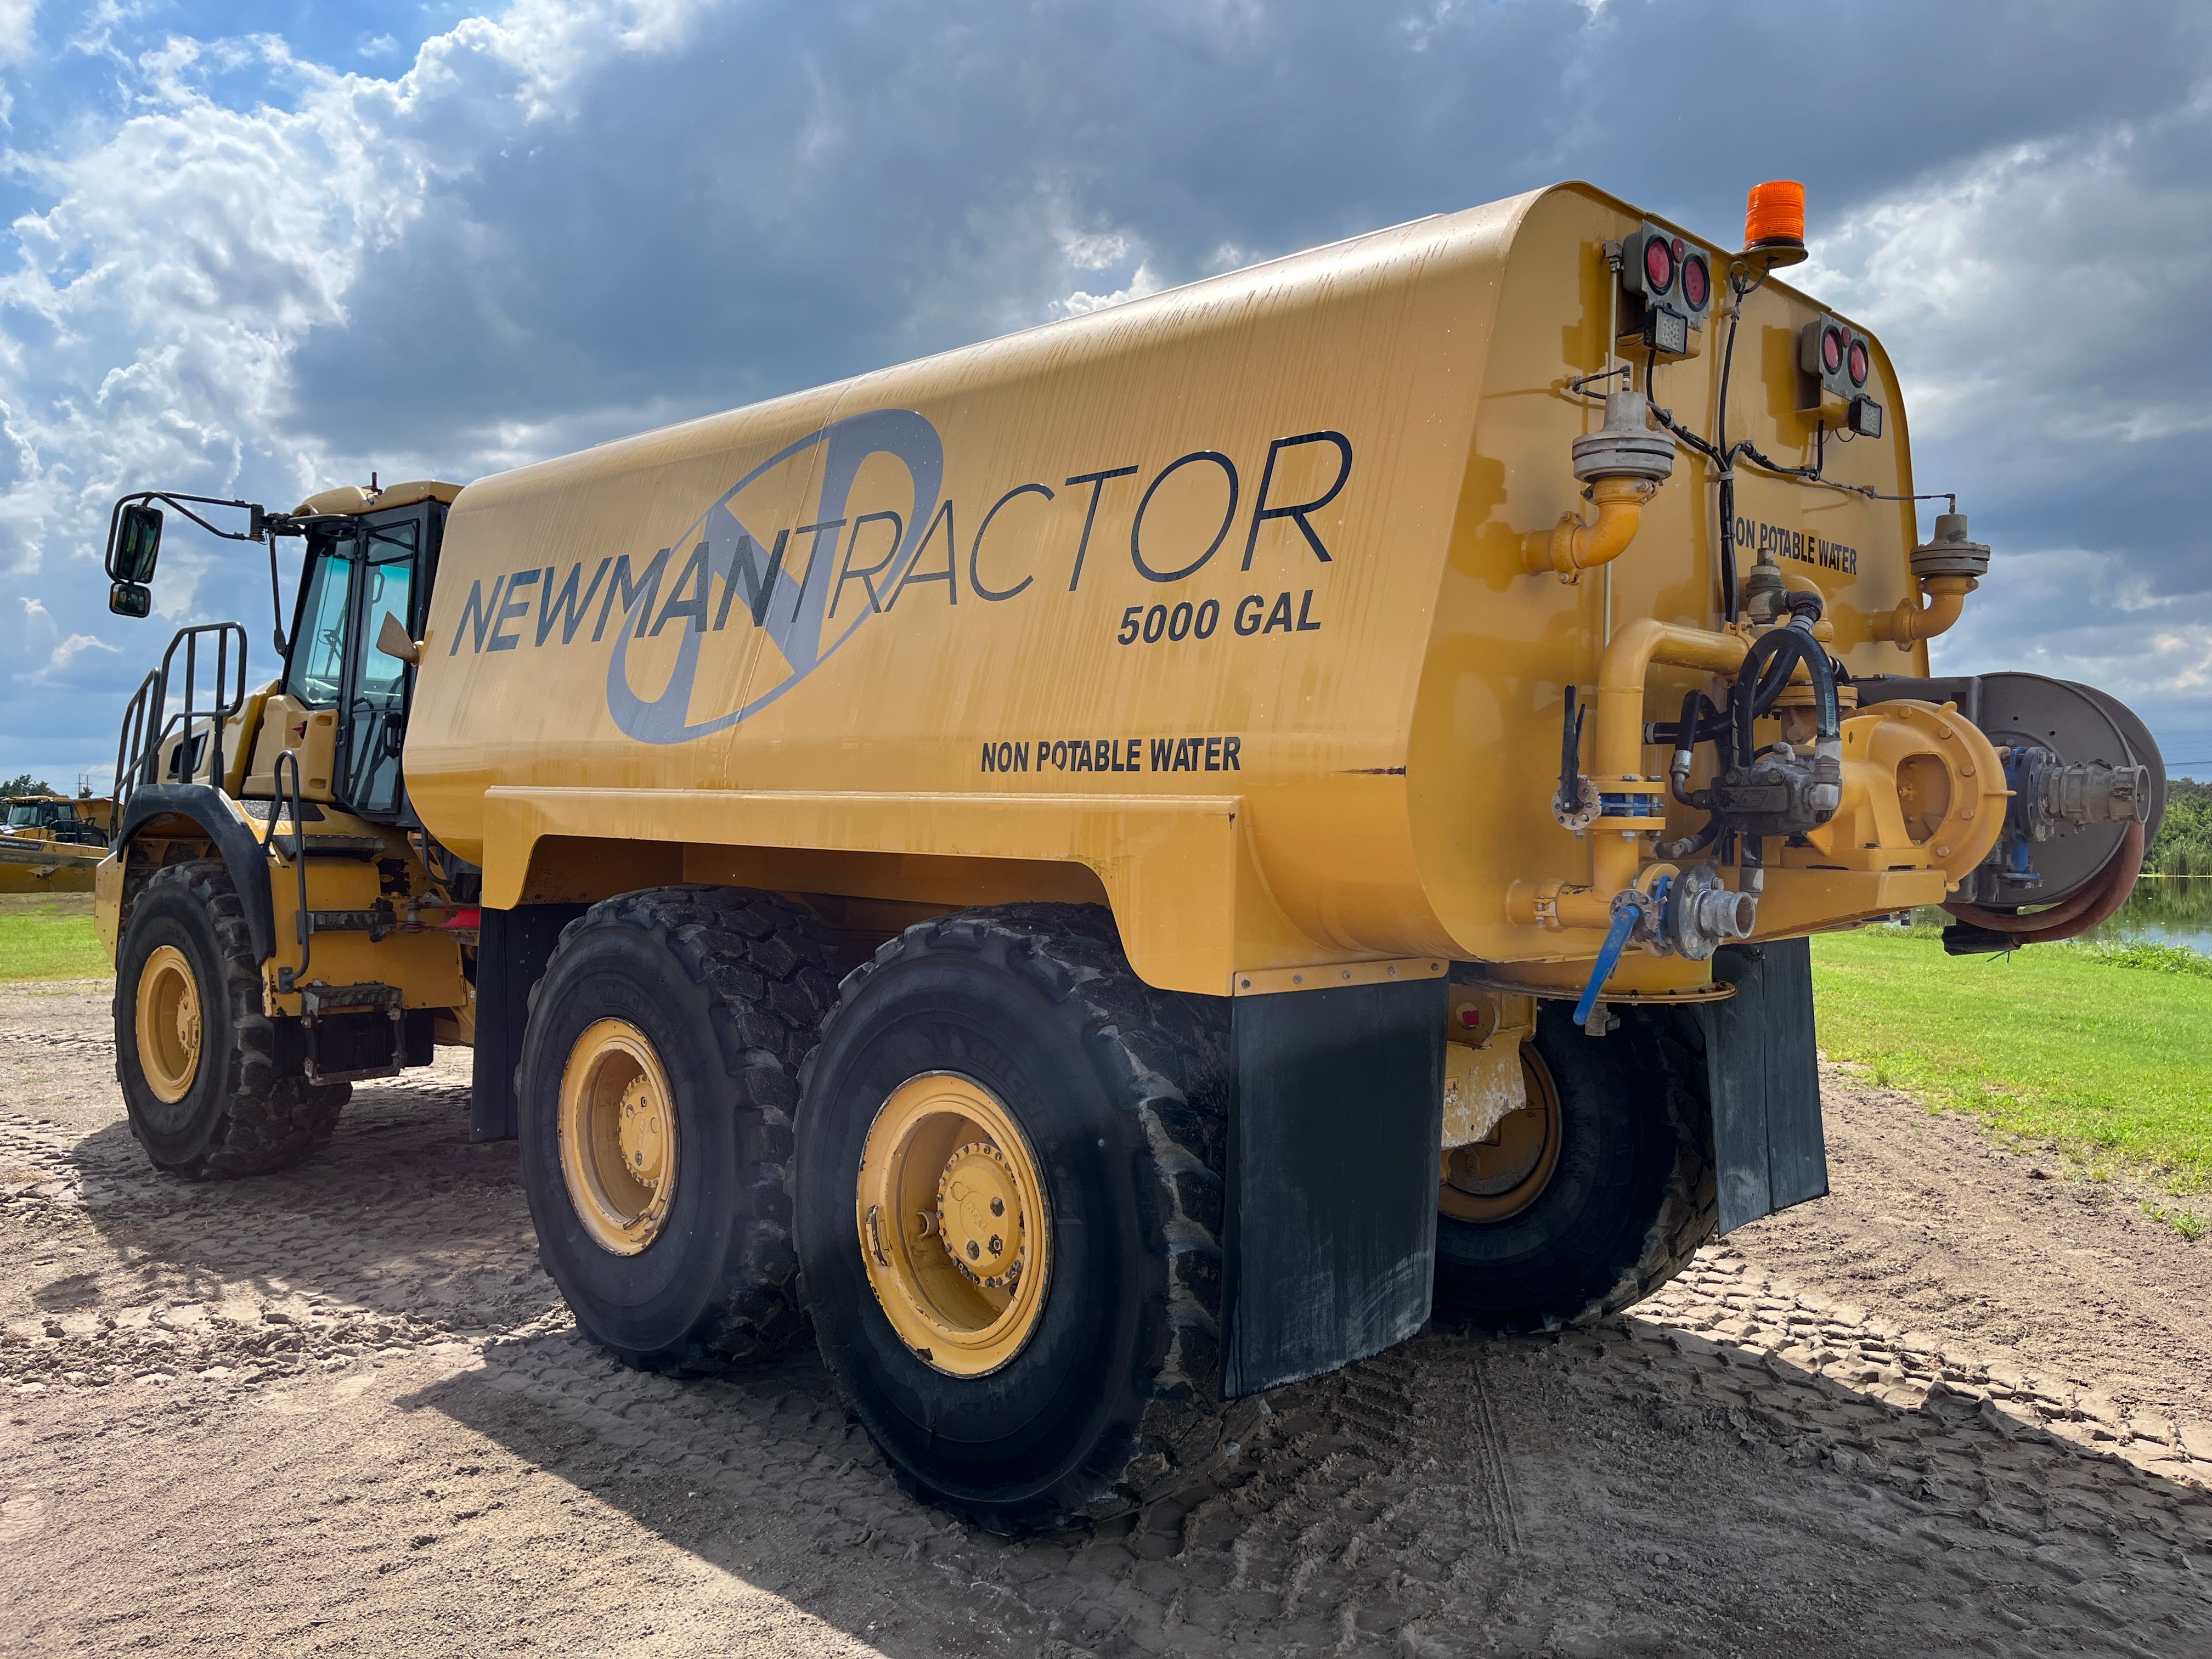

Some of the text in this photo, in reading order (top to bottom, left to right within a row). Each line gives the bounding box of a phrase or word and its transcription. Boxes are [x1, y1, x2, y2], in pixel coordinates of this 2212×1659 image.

[1736, 516, 1857, 575] ON POTABLE WATER
[1118, 589, 1322, 645] 5000 GAL
[981, 736, 1242, 772] NON POTABLE WATER
